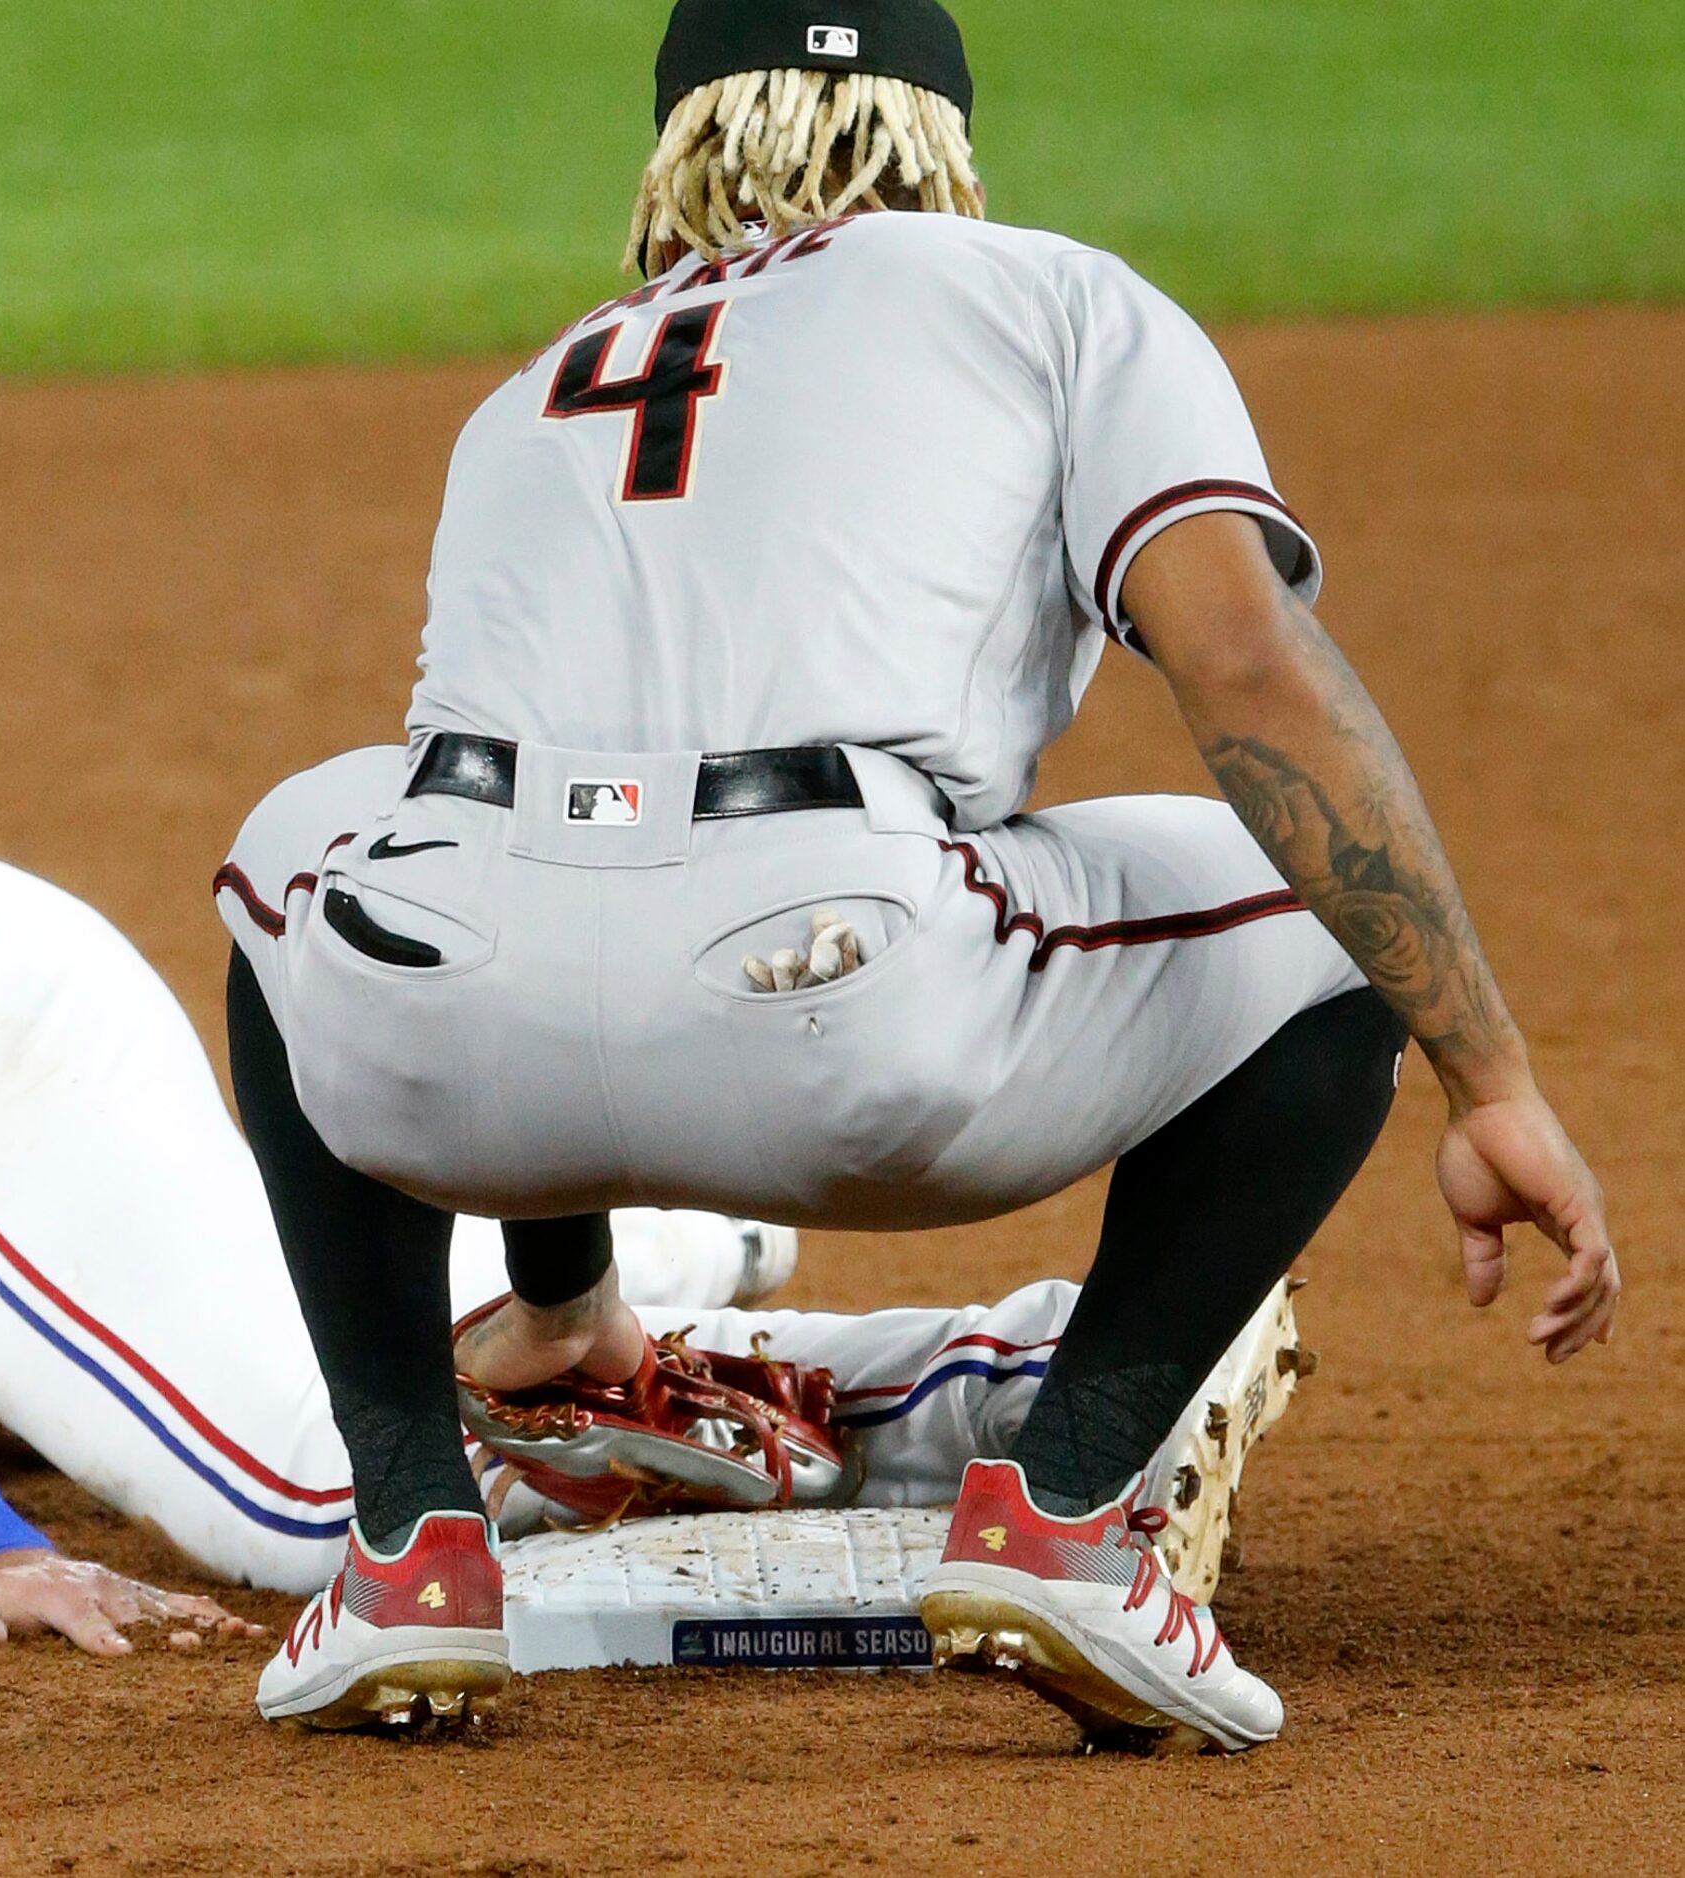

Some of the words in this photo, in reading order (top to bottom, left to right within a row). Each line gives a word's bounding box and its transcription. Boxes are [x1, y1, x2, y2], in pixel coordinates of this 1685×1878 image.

[538, 298, 732, 505] 4
[977, 1524, 1008, 1552] 4
[416, 1581, 447, 1609] 4
[711, 1629, 848, 1657] INAUGURAL
[854, 1628, 928, 1655] SEASO
